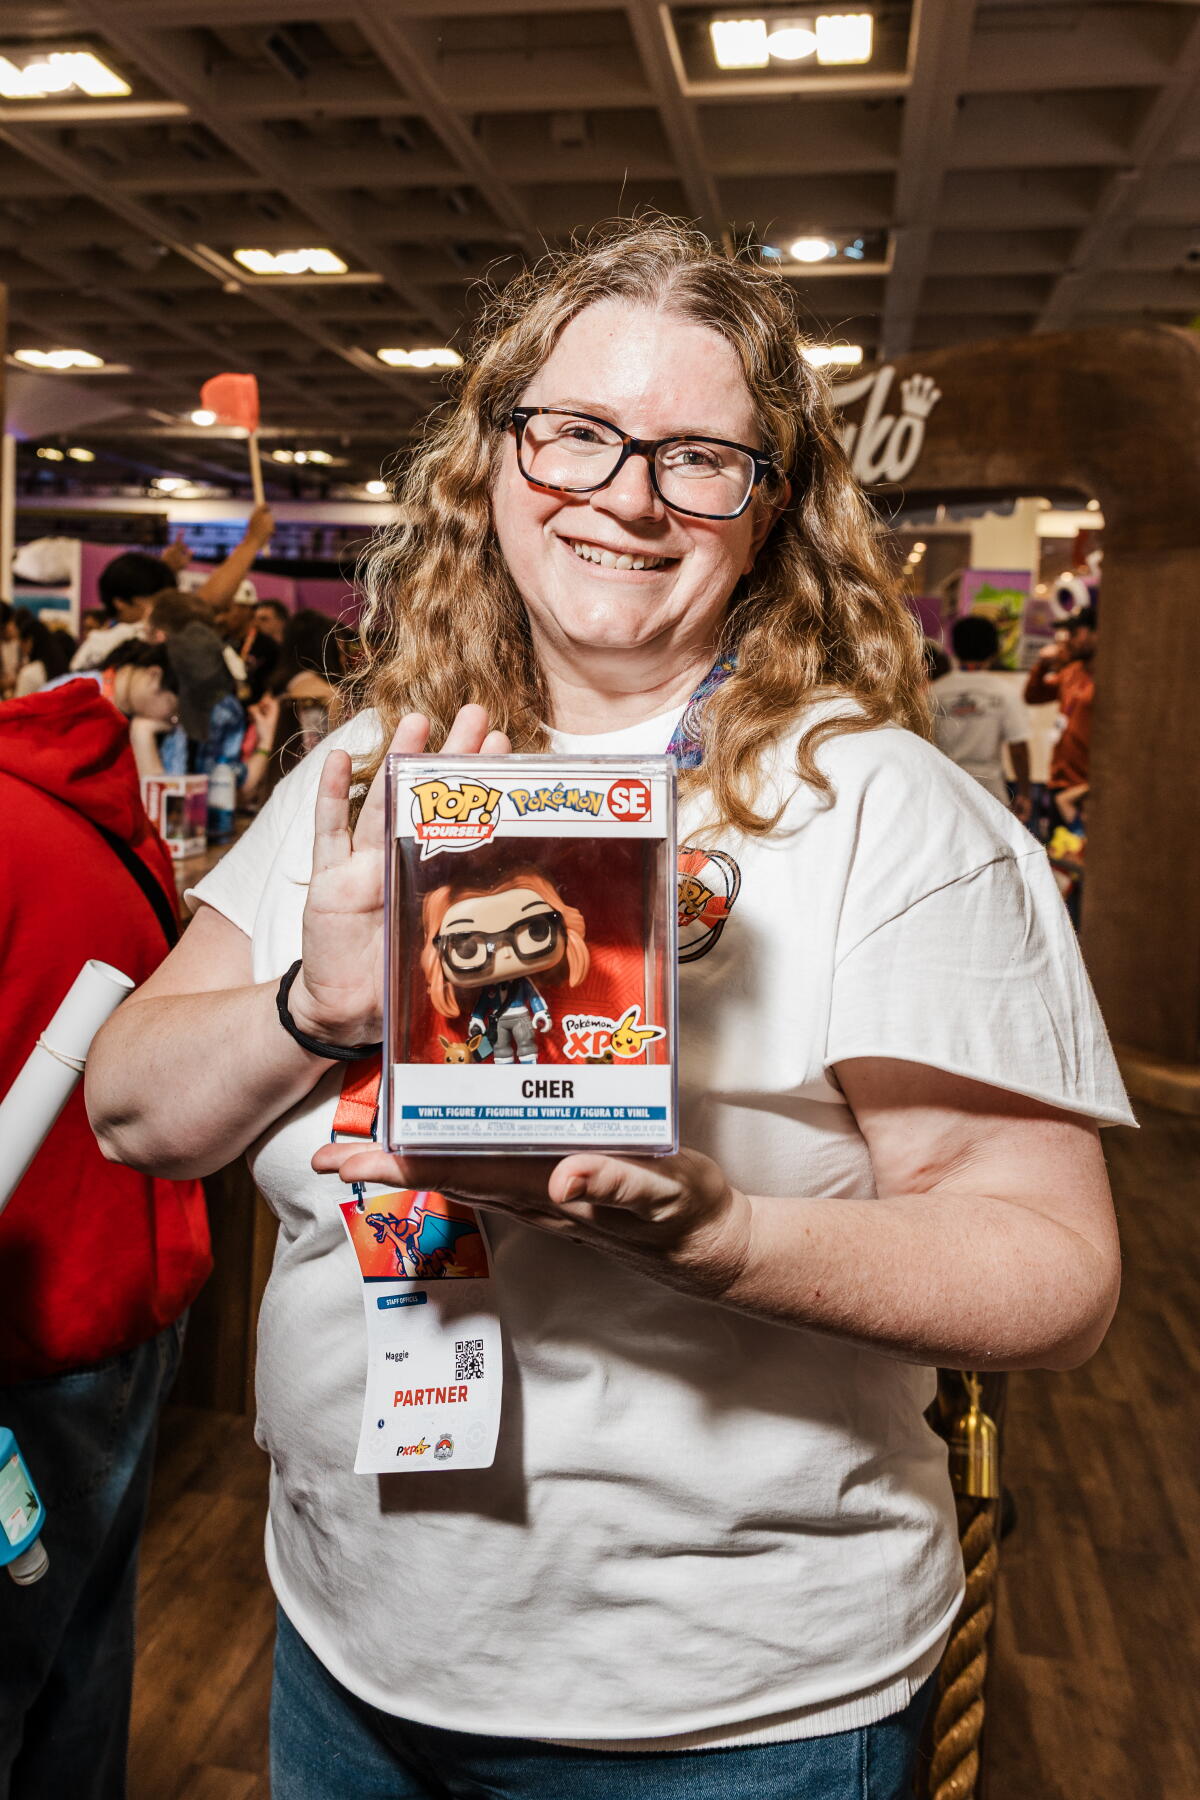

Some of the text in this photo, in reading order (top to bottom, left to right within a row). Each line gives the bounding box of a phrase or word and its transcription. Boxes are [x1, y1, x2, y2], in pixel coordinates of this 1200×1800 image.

[409, 781, 503, 824] POP!
[611, 787, 647, 814] SE
[422, 826, 489, 837] YOURSELF
[568, 1031, 612, 1055] XP
[521, 1079, 574, 1099] CHER
[418, 1108, 650, 1118] VINYL FIGURE / FIGURINE EN VINYLE / FIGURA DE VINIL
[386, 1298, 400, 1306] STAFF
[385, 1350, 409, 1363] Maggie
[393, 1385, 468, 1408] PARTNER
